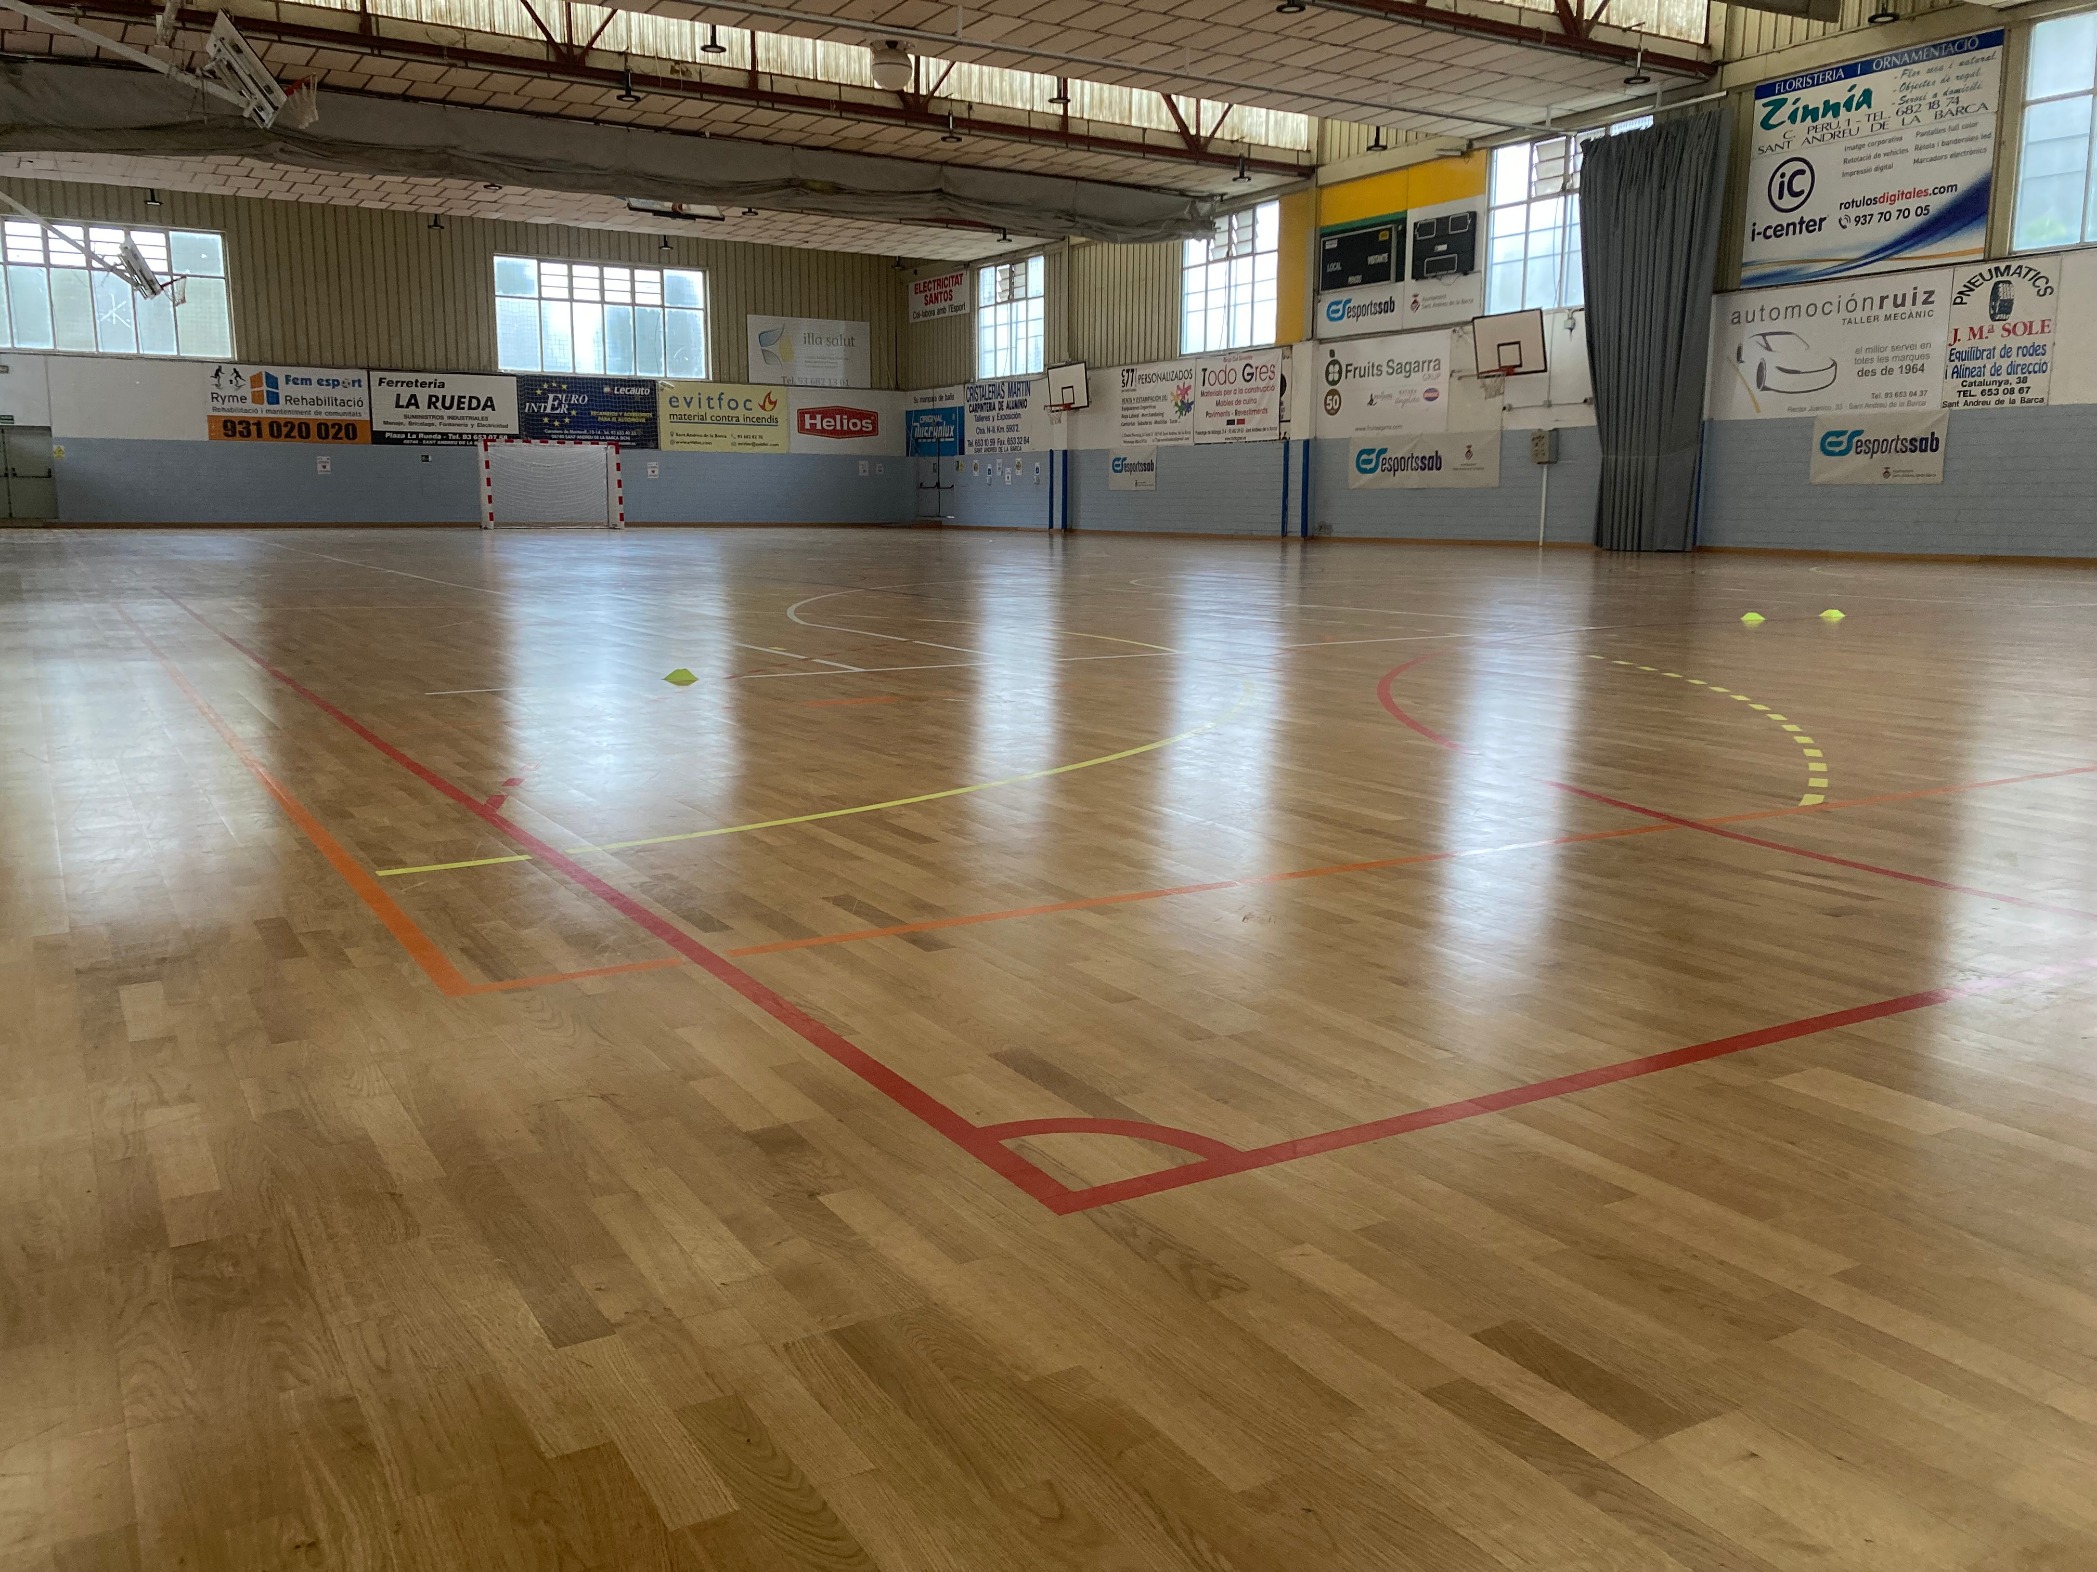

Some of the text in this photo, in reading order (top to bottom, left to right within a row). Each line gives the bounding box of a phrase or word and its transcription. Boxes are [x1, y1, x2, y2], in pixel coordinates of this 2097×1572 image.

[1775, 36, 1980, 94] FLORISTERIA I ORNAMENTACIÓ
[1760, 84, 1873, 131] Zinnia
[1865, 112, 1891, 124] TEL.
[1896, 103, 1922, 117] 682
[1926, 100, 1940, 110] 18
[1946, 95, 1960, 107] 74
[1758, 102, 1989, 156] SANT ANDREU DE LA BARCA
[1839, 182, 1958, 211] rotulosdigitales.com
[1854, 205, 1930, 227] 937 70 70 05
[1751, 215, 1827, 242] i-center
[914, 273, 964, 295] ELECTRICITAT
[1952, 264, 2055, 306] PNEUMATICS
[924, 289, 953, 306] SANTOS
[1346, 296, 1395, 322] esportssab
[1842, 309, 1934, 326] TALLER MECÀNIC
[803, 332, 856, 348] illa salut
[1948, 328, 1961, 346] J.
[2001, 319, 2051, 338] SOLE
[1892, 353, 1930, 363] marques
[1948, 342, 2046, 362] Equilibrat de rodes
[1138, 369, 1192, 384] PERSONALIZADOS
[1202, 363, 1276, 387] Todo Gres
[1345, 358, 1441, 381] Fruits Sagarra
[1857, 363, 1925, 377] des de 1964
[1951, 362, 1986, 379] Alineat
[1990, 361, 2002, 376] de
[285, 375, 312, 386] Fem
[378, 377, 446, 389] Ferreteria
[1961, 376, 2028, 388] Catalunya, 38
[211, 392, 364, 408] Ryme Rehabilitació
[966, 381, 1030, 402] CRISTALERIAS MARTIN
[1224, 388, 1232, 397] per
[1957, 386, 2031, 398] TEL. 653 08 67
[394, 393, 496, 411] LA RUEDA
[669, 392, 752, 411] evitfoc
[969, 398, 1027, 413] CARPINTERIA DE ALUMINIO
[1326, 397, 1341, 408] 50
[1963, 399, 1991, 407] Andreu
[670, 412, 779, 424] material contra incendis
[804, 414, 873, 431] Helios
[223, 419, 358, 440] 931 020 020
[1855, 431, 1940, 459] esportssab
[1124, 459, 1154, 476] esportssab
[1381, 451, 1442, 477] esportssab
